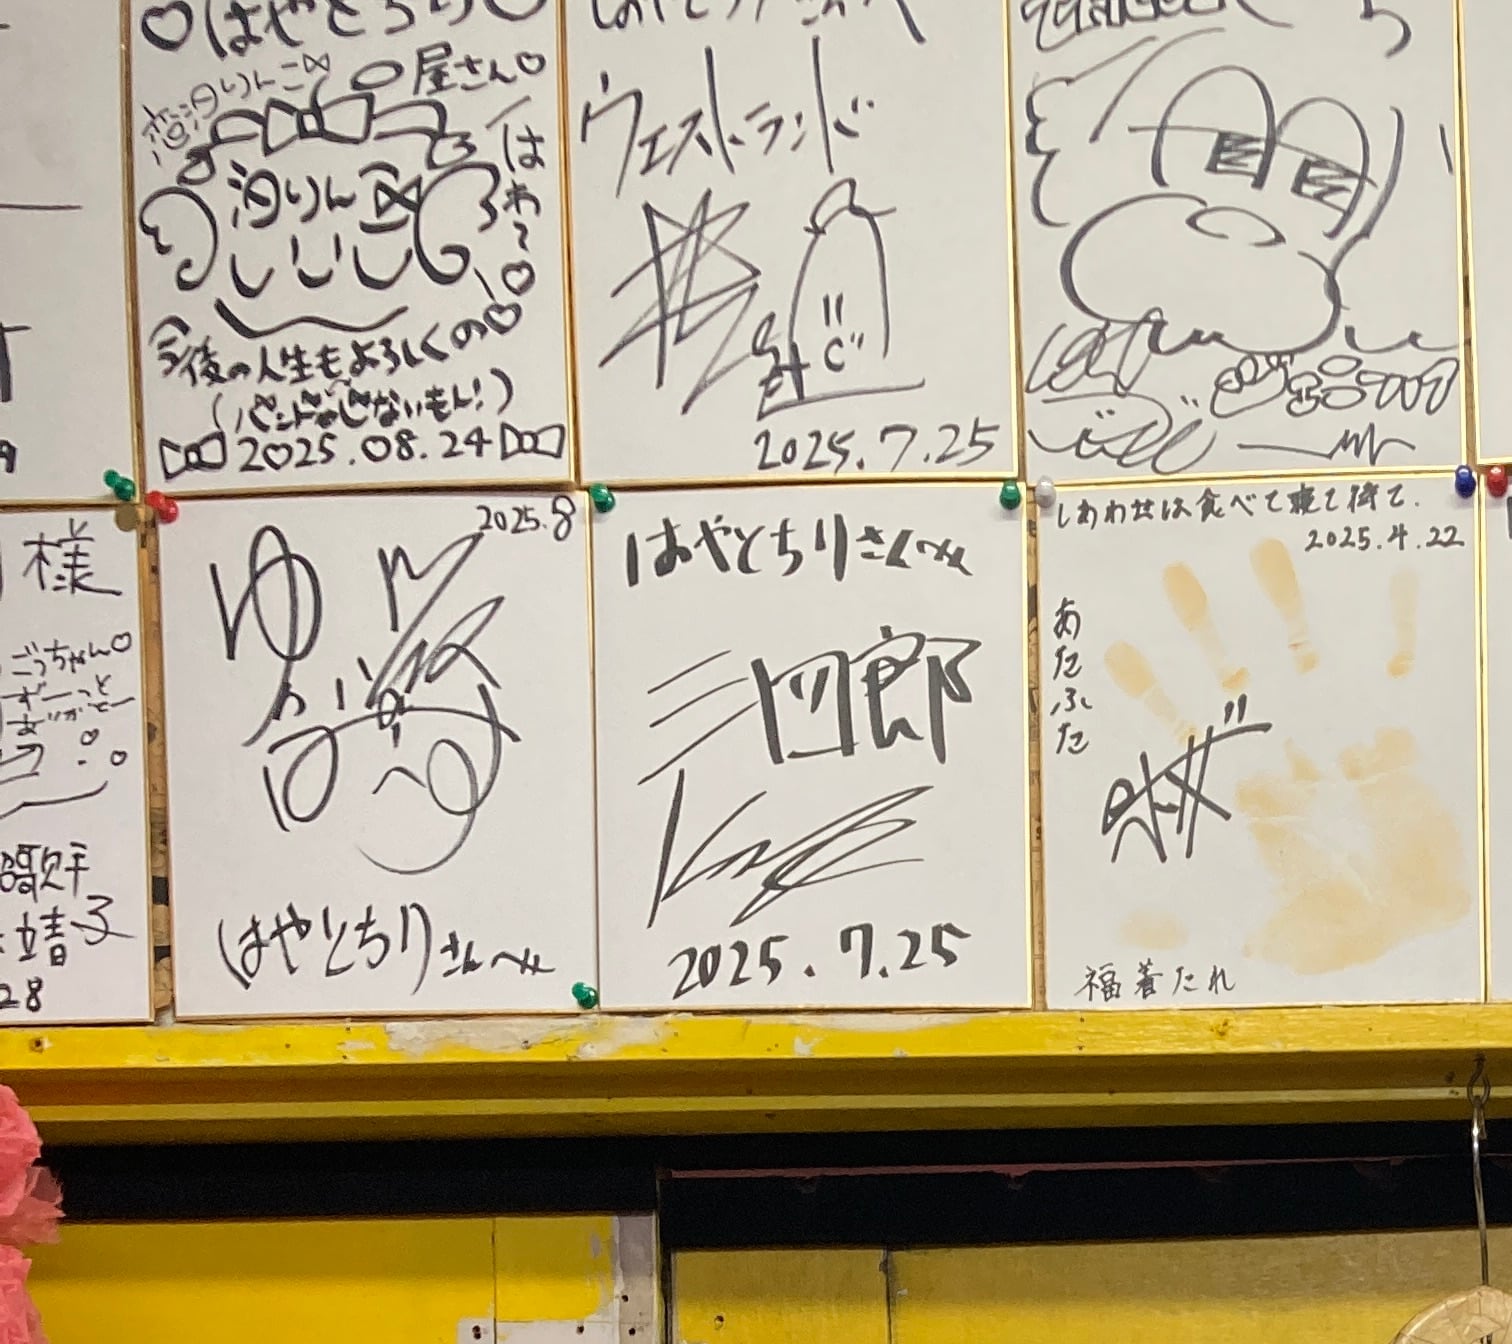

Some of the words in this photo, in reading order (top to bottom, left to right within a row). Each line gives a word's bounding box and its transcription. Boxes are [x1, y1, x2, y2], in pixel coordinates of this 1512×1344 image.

[754, 417, 1000, 474] 2025.7.25
[476, 495, 577, 541] 2025.8
[1304, 523, 1466, 552] 2025.4.22
[0, 518, 122, 597] 様
[668, 922, 972, 1000] 2025.7.25
